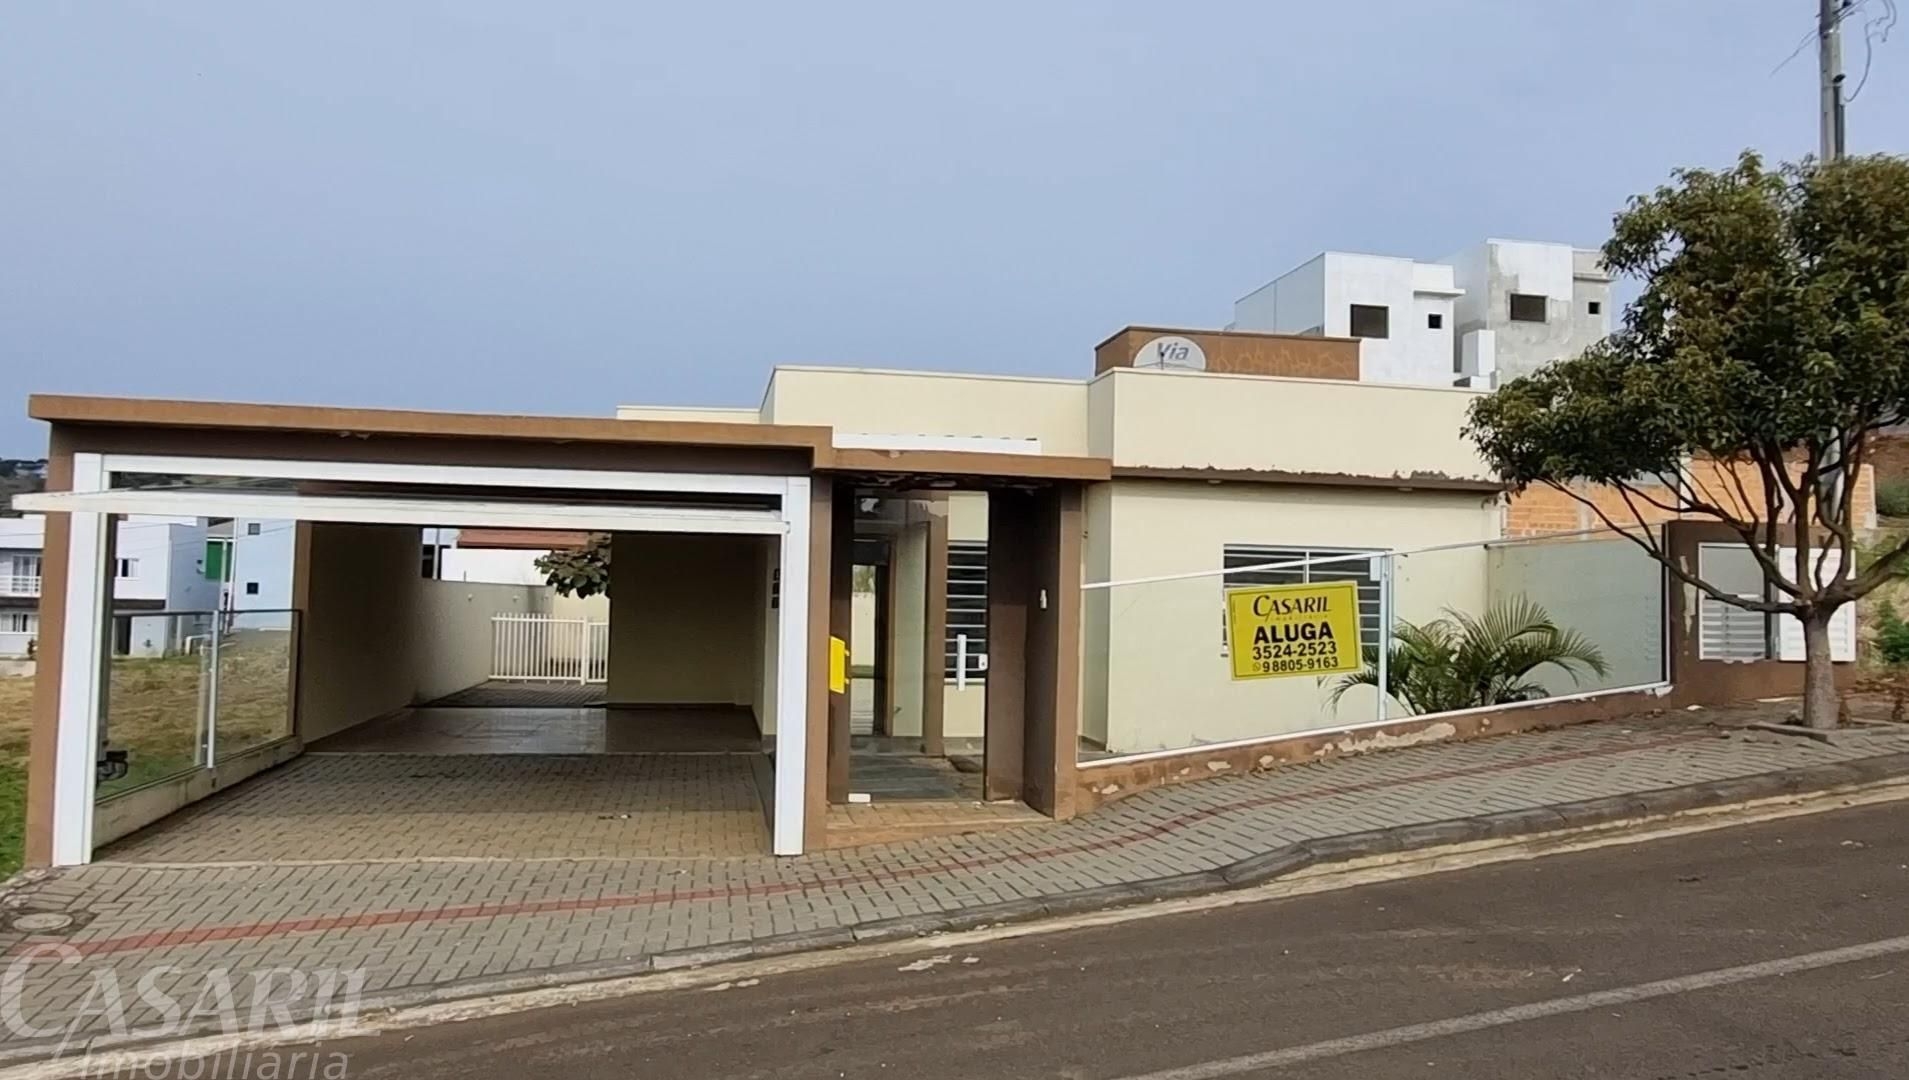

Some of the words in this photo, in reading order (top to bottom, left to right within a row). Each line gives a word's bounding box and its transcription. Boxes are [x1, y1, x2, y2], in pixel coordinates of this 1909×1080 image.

[1158, 342, 1189, 360] Via
[1254, 595, 1331, 621] CASARIL
[1254, 622, 1334, 645] ALUGA
[1252, 641, 1337, 660] 3524-2523
